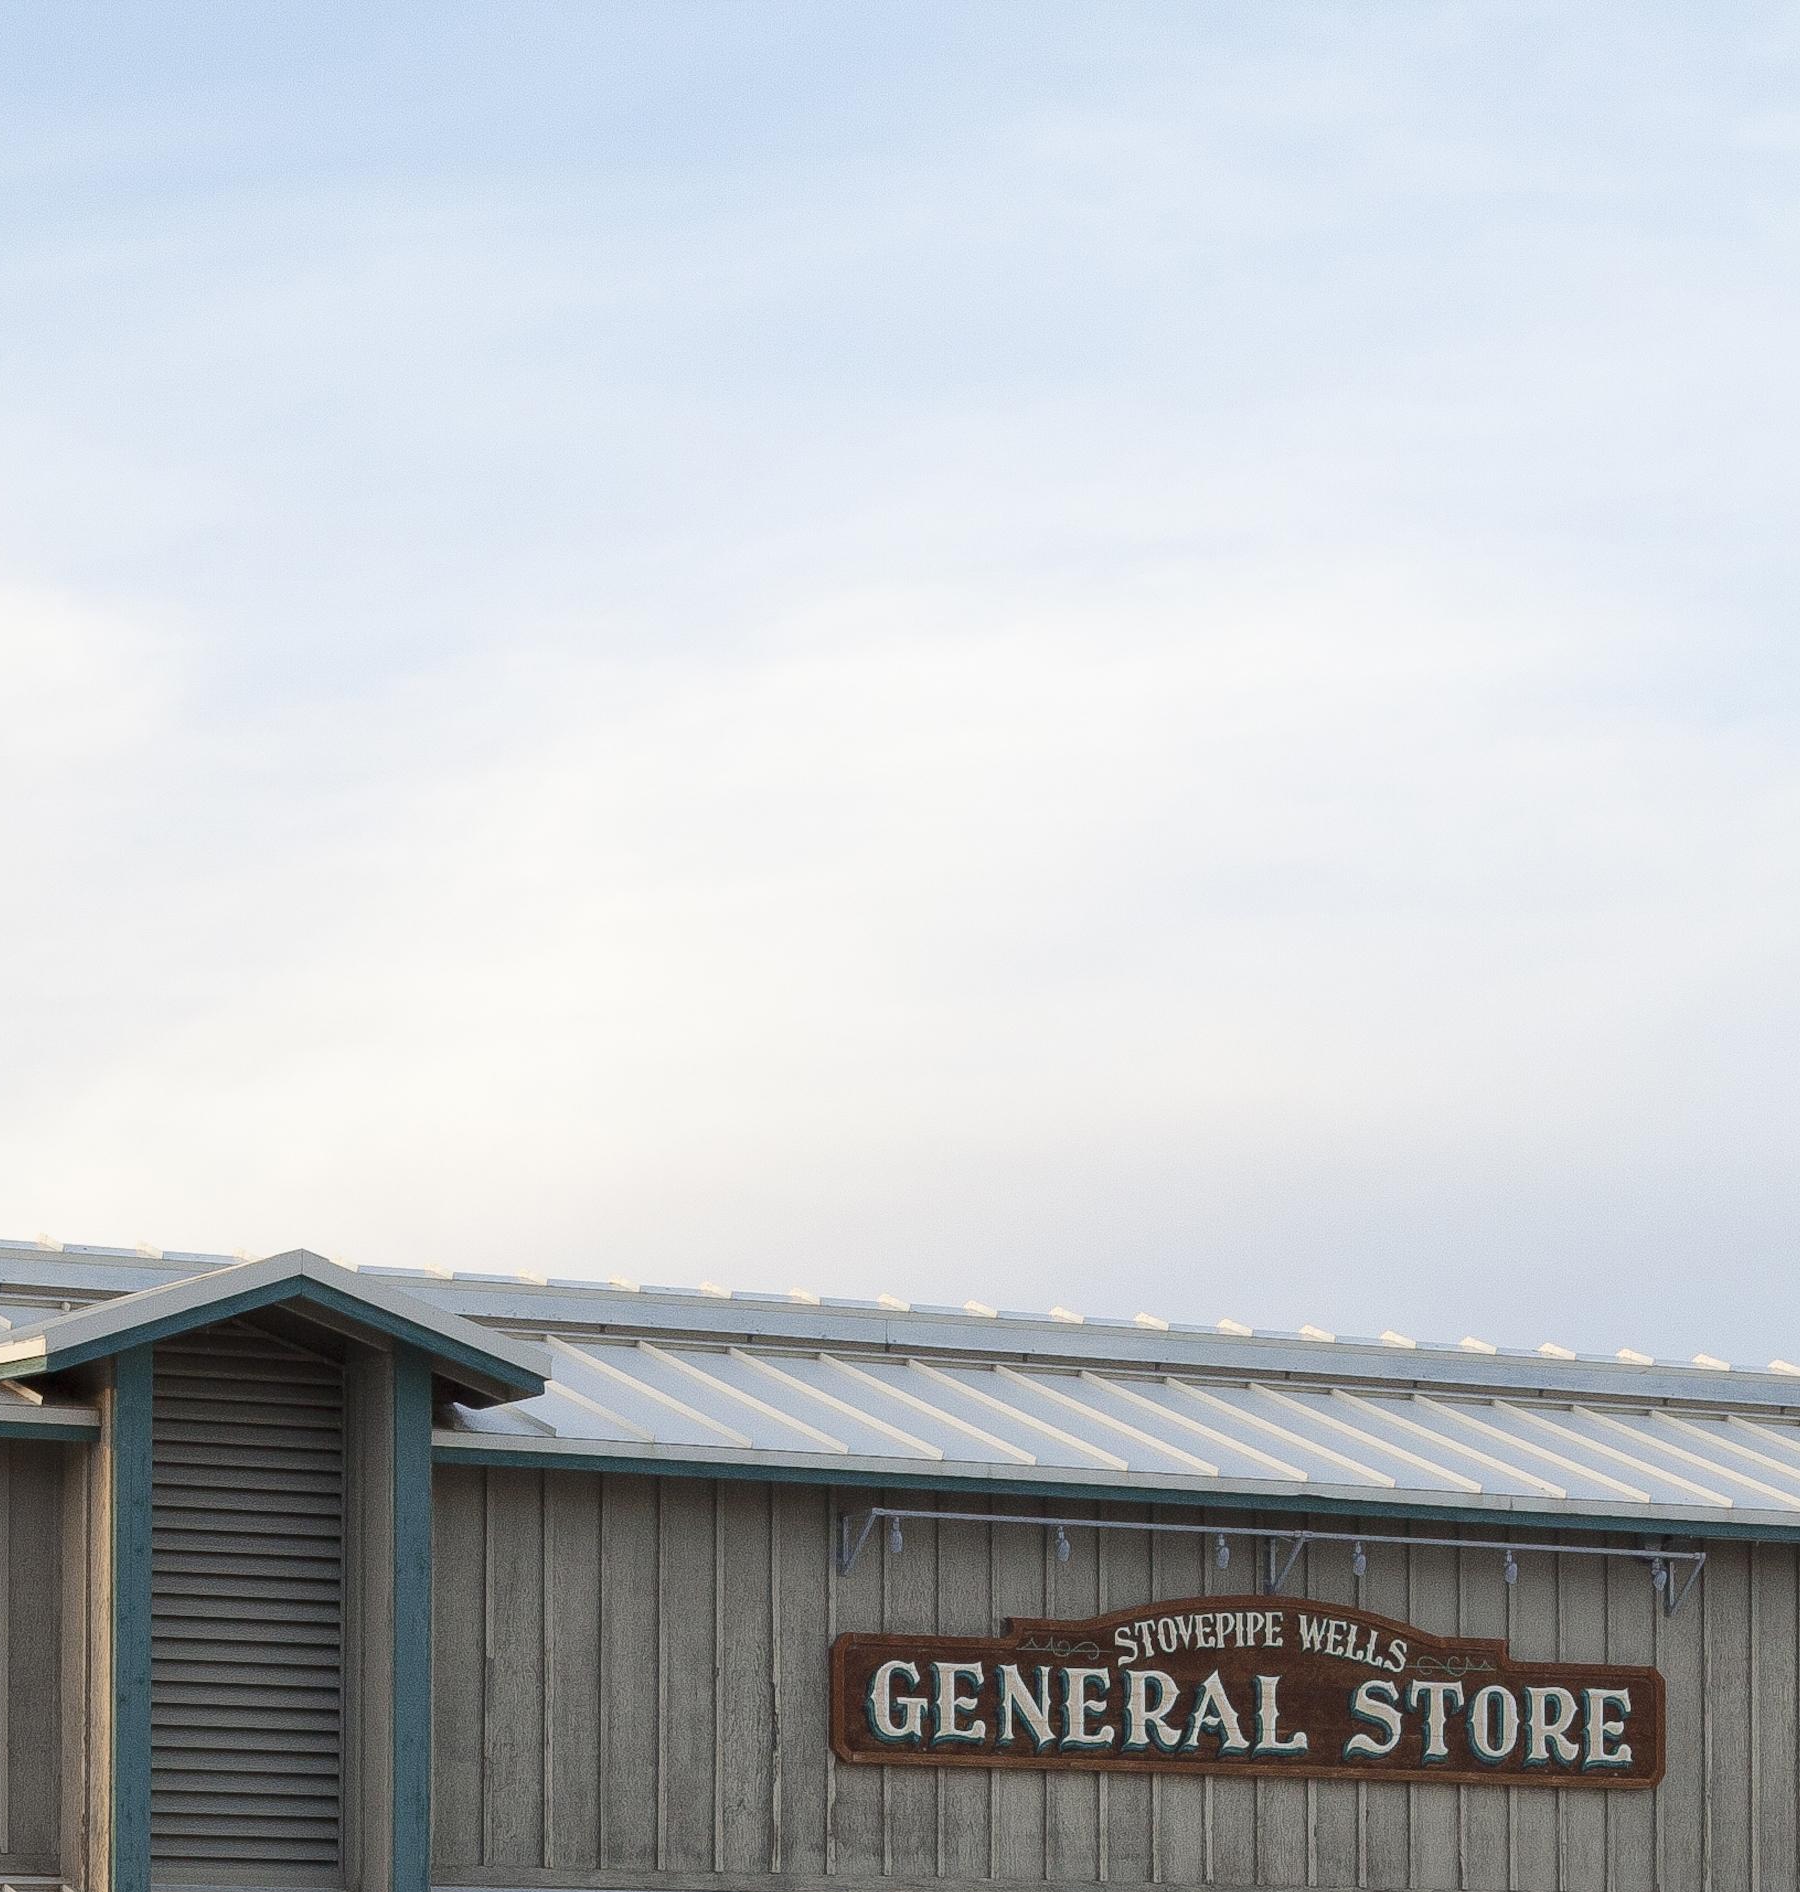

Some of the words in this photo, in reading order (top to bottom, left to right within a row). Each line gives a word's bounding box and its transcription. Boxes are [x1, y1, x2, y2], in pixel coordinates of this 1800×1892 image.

[1114, 1611, 1284, 1667] STOVEPIPE
[1298, 1613, 1408, 1673] WELLS
[868, 1659, 1309, 1758] GENERAL
[1343, 1678, 1633, 1771] STORE
